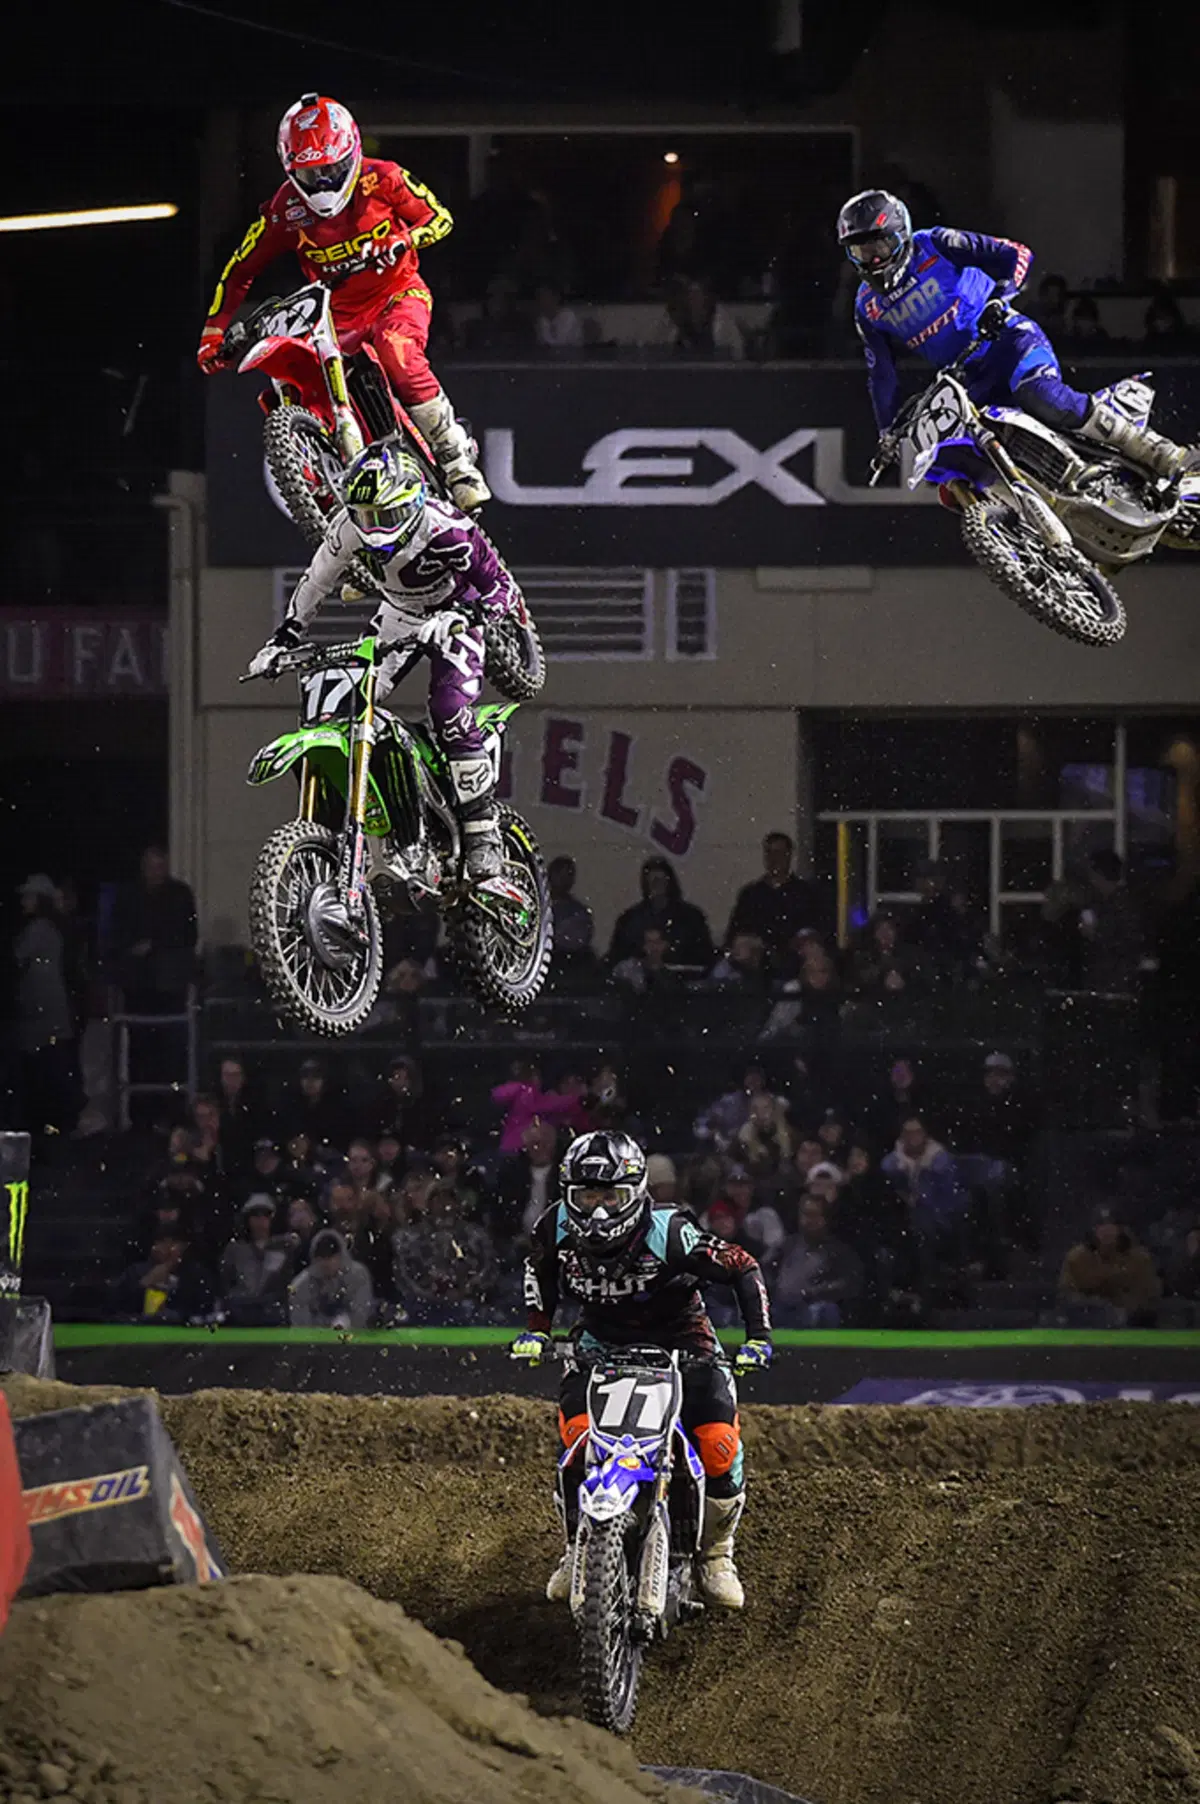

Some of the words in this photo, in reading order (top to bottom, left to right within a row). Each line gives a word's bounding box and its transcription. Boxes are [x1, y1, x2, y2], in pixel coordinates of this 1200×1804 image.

[360, 171, 379, 197] 32
[304, 219, 391, 263] GEICO
[881, 276, 946, 336] THOR
[917, 385, 961, 453] 63
[485, 427, 1012, 507] LEXU
[72, 625, 170, 686] FA
[304, 667, 366, 721] 17
[495, 717, 707, 856] ELS
[596, 1377, 673, 1430] 11
[651, 1531, 664, 1599] DUNLOP
